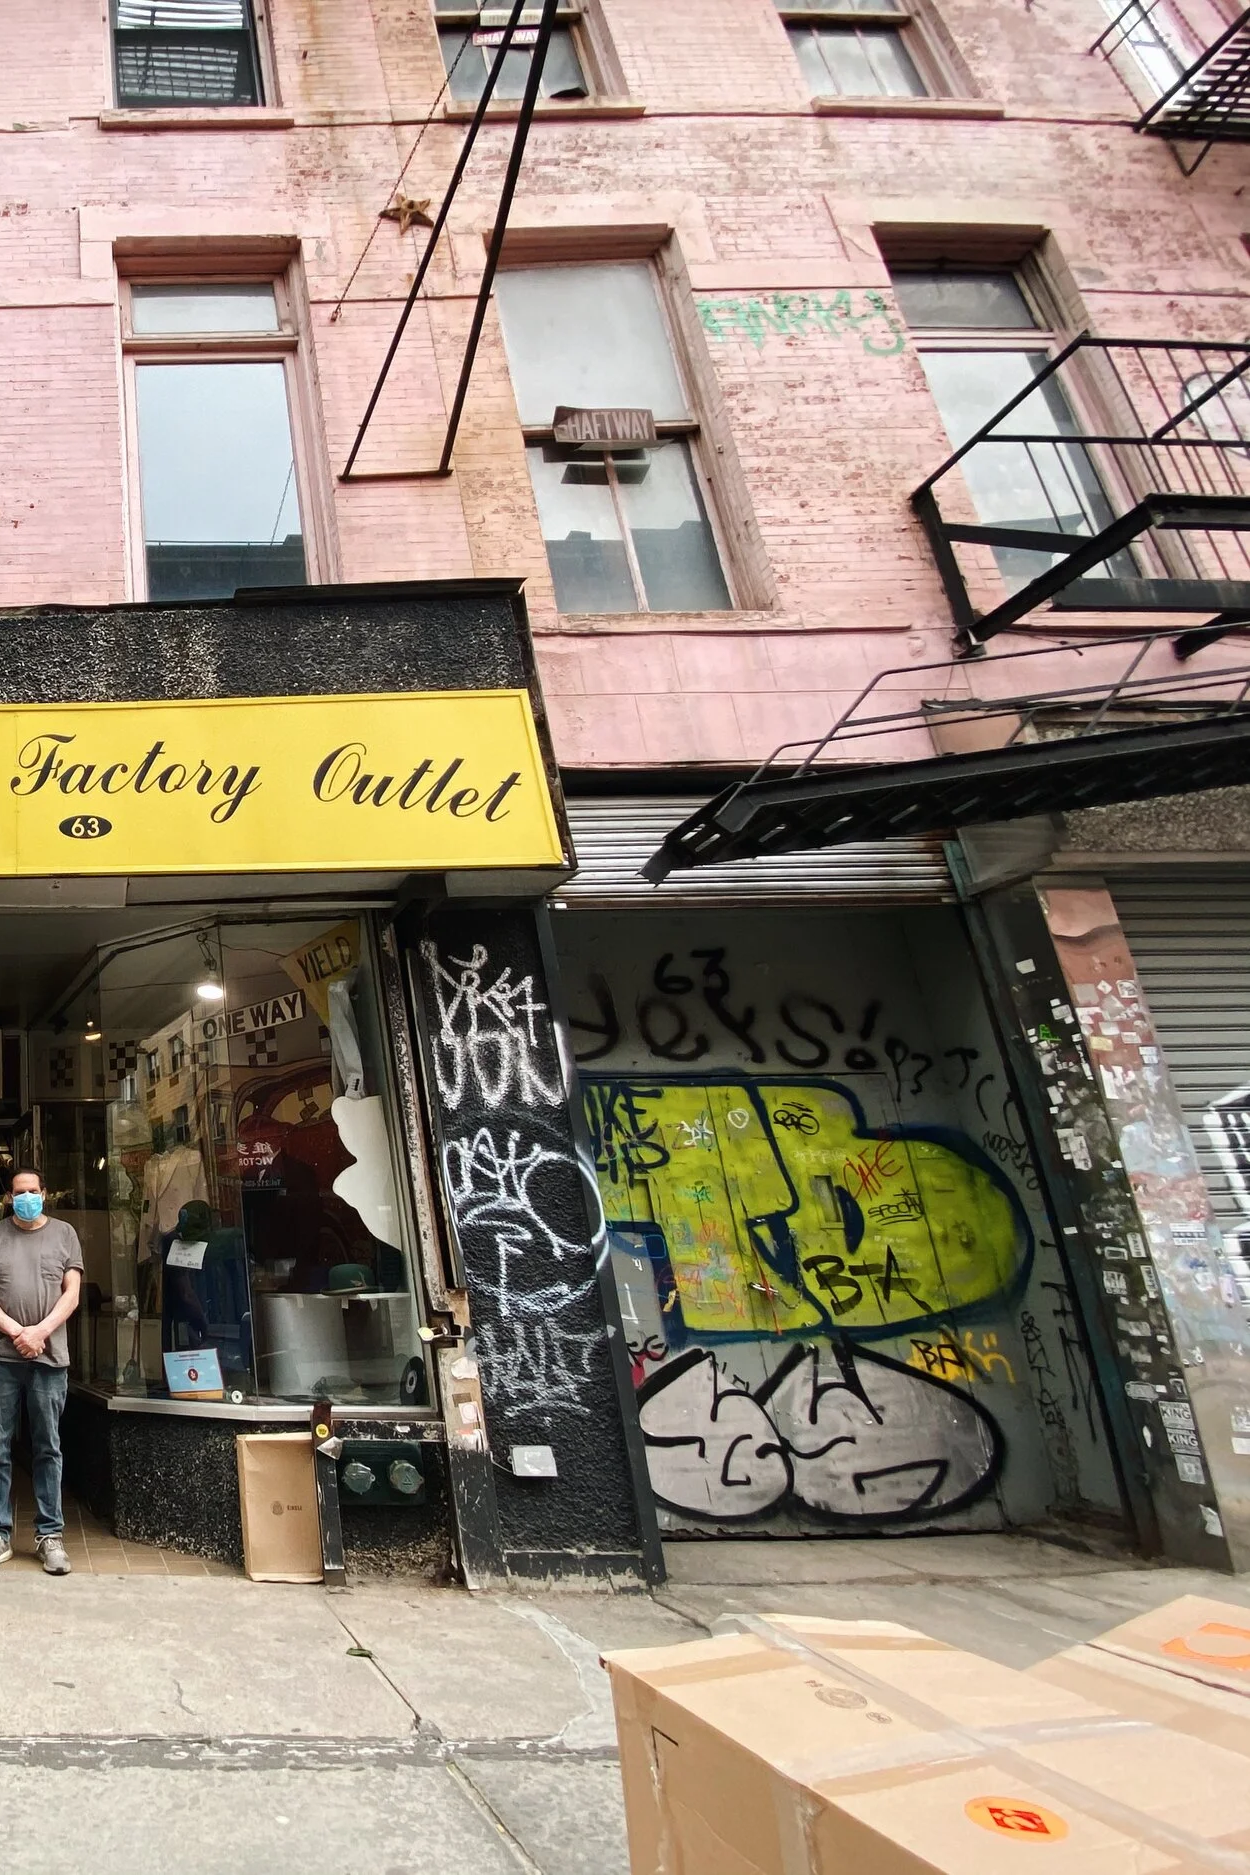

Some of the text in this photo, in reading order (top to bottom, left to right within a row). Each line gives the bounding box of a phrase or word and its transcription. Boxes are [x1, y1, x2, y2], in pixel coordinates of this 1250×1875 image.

[10, 734, 262, 824] Factory
[313, 742, 522, 822] Outlet
[71, 817, 100, 837] 63
[297, 936, 352, 983] YIELD
[203, 993, 298, 1039] ONE WAY
[1161, 1408, 1191, 1420] KING
[1168, 1433, 1199, 1447] KING
